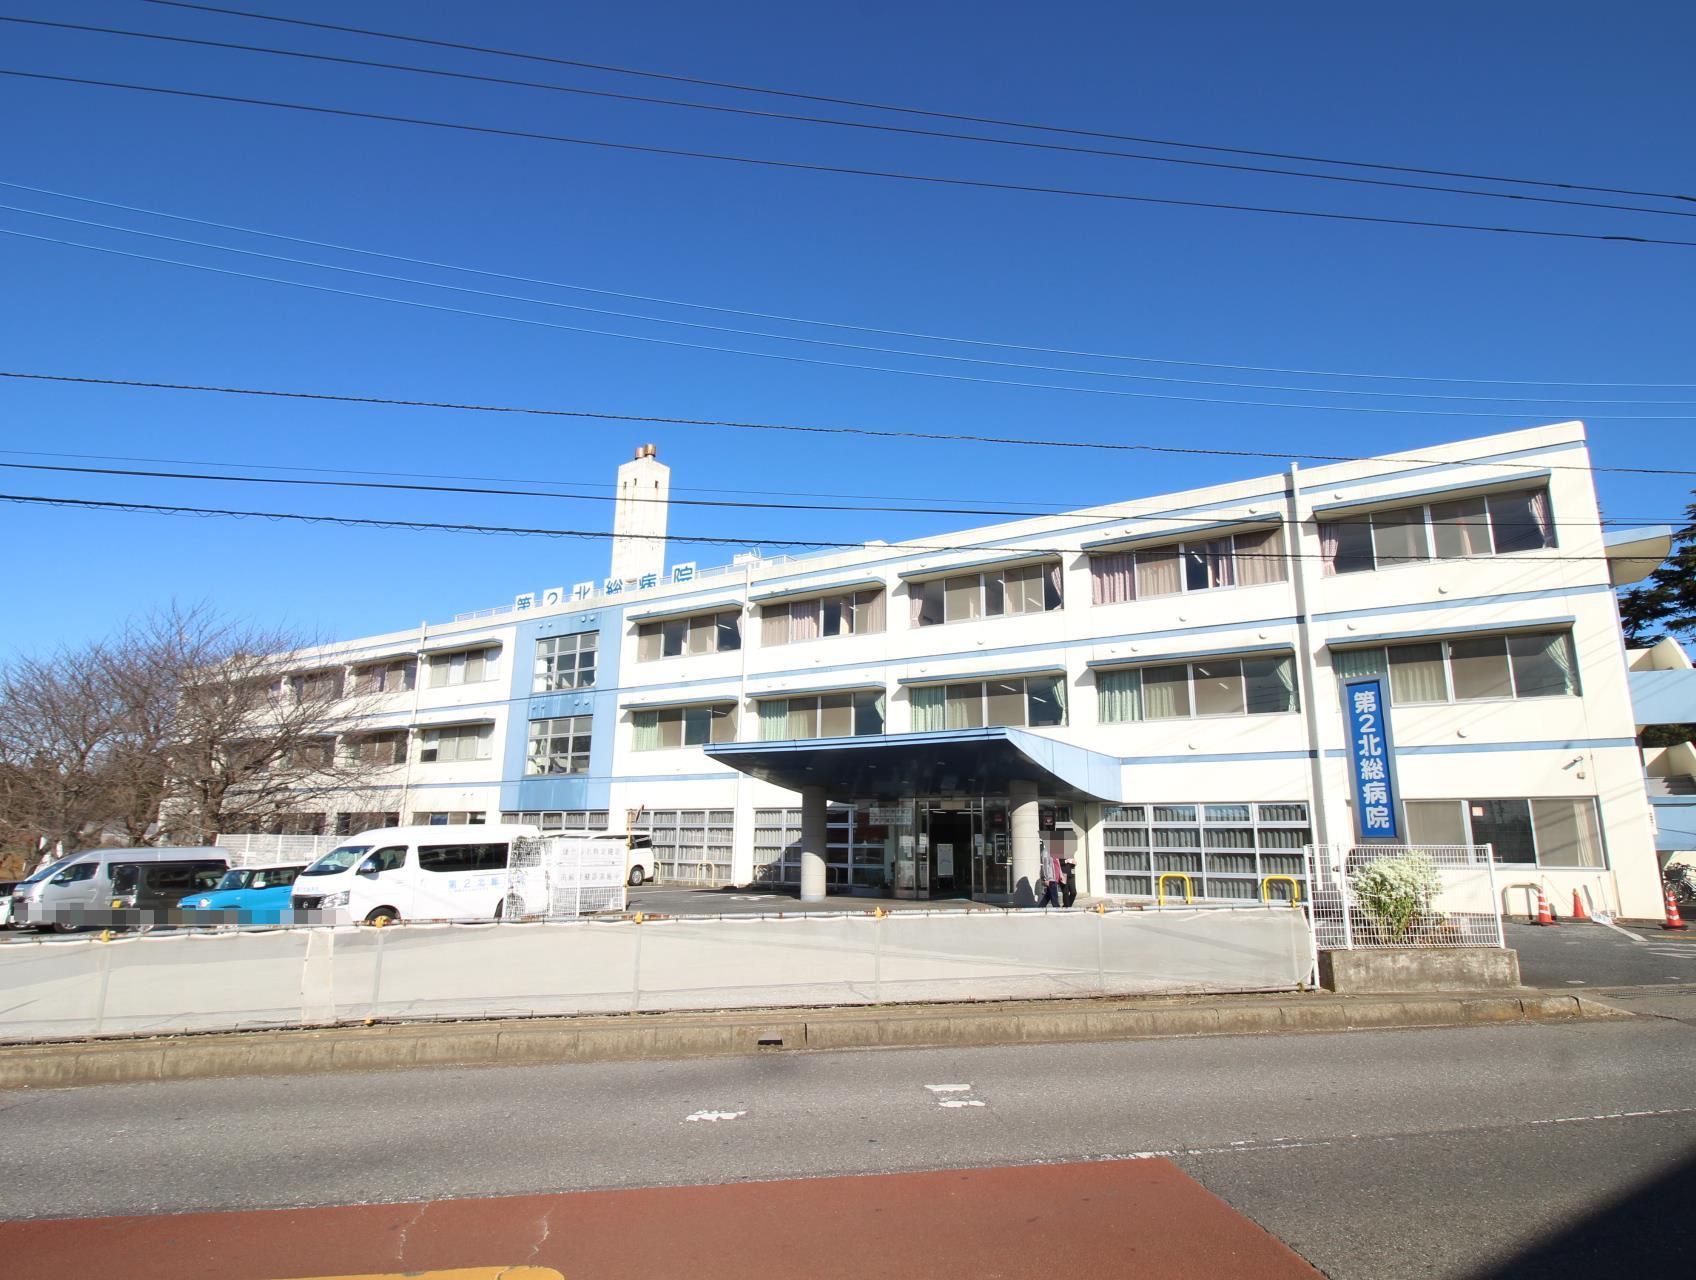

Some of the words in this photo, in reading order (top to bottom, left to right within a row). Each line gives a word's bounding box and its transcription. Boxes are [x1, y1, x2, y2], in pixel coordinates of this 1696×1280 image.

[1353, 690, 1390, 829] 第2北総病院
